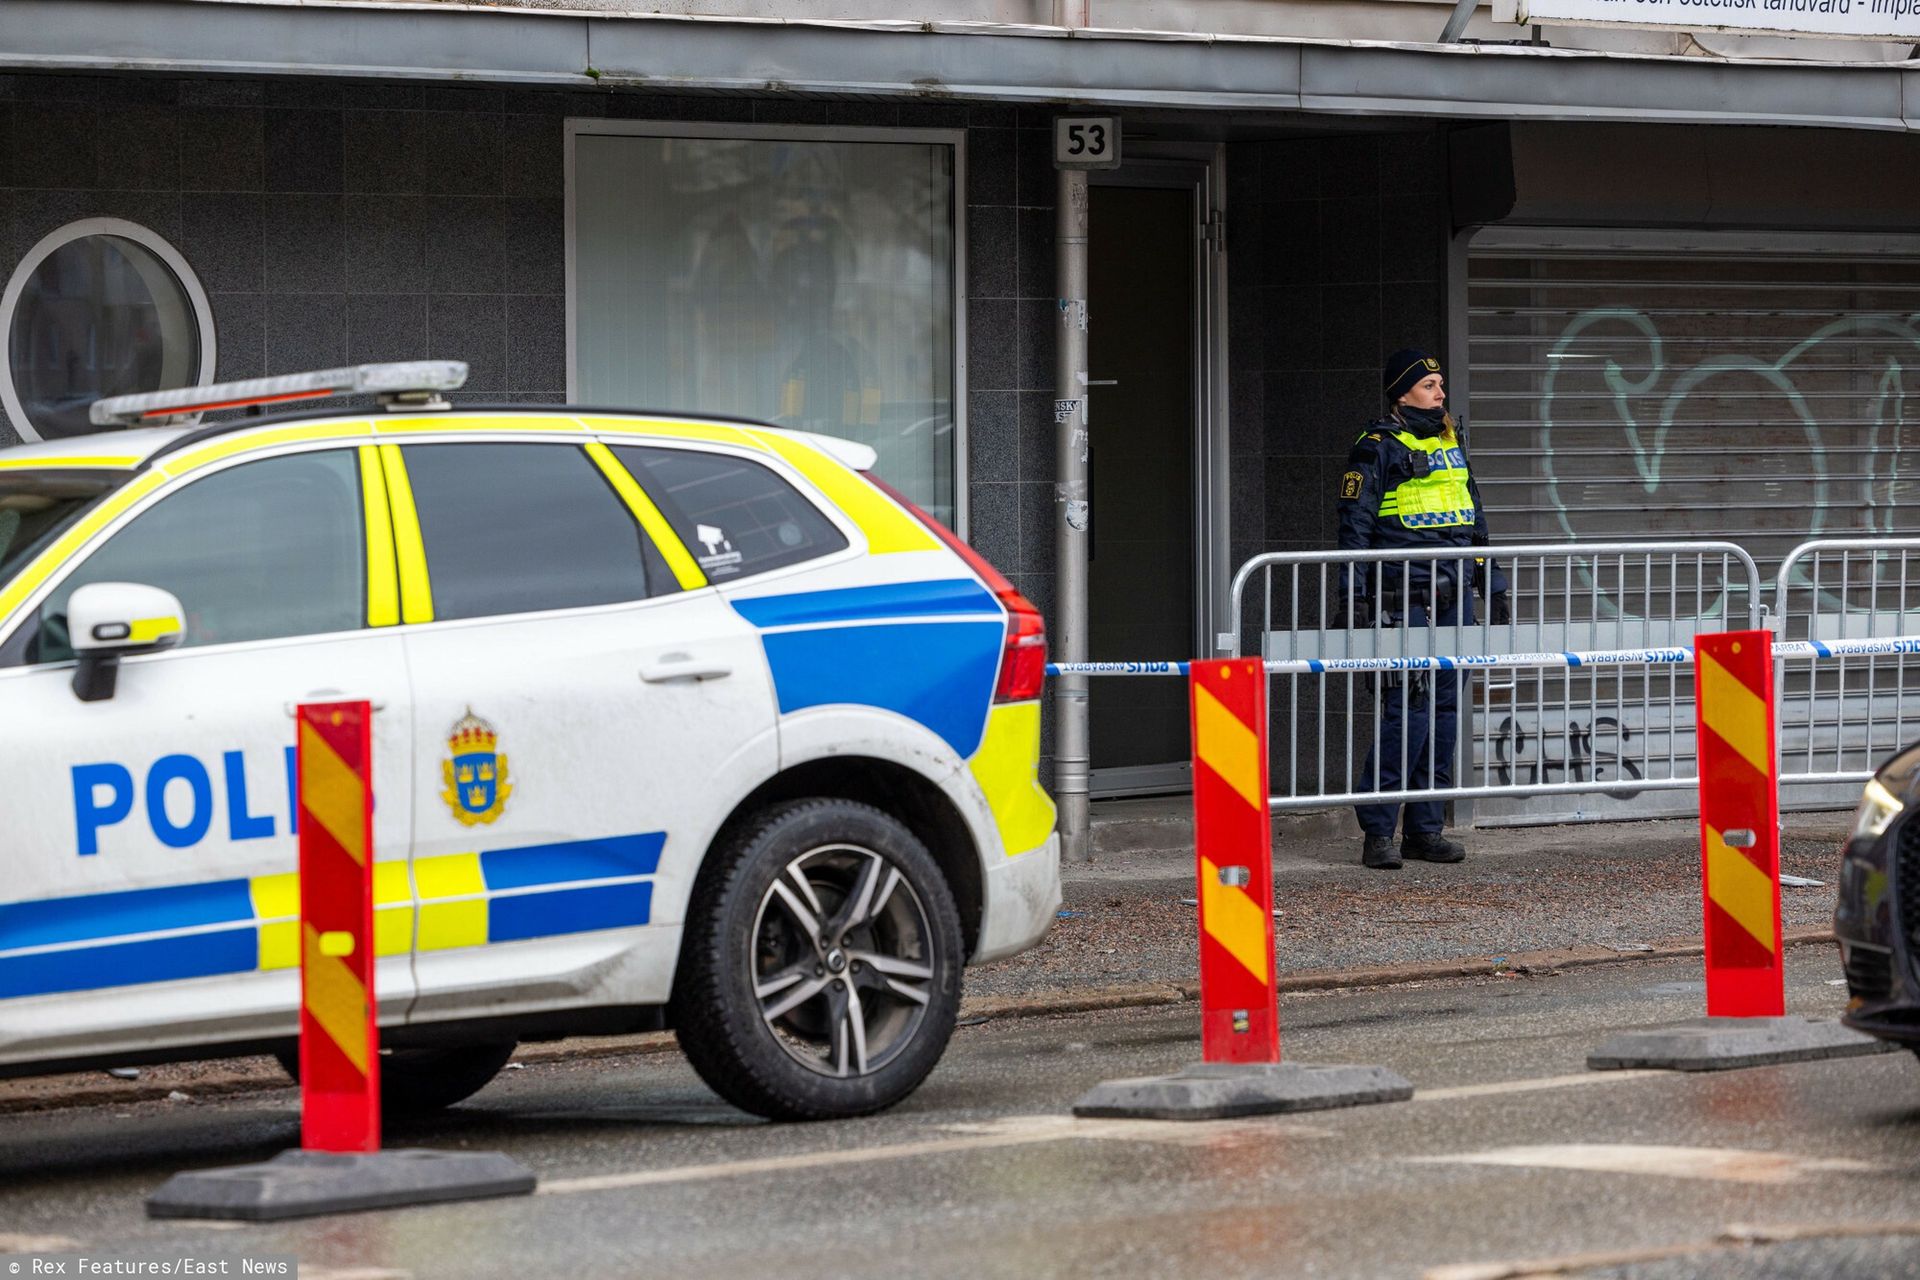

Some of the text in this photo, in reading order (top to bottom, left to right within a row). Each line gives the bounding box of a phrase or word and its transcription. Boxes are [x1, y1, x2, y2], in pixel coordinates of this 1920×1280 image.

[1068, 124, 1105, 155] 53
[1428, 449, 1463, 467] OIS
[1893, 639, 1920, 654] OLIS
[1389, 657, 1431, 669] POLIS
[1644, 650, 1685, 663] POLIS
[1126, 662, 1169, 673] POLIS
[71, 745, 375, 856] POLI
